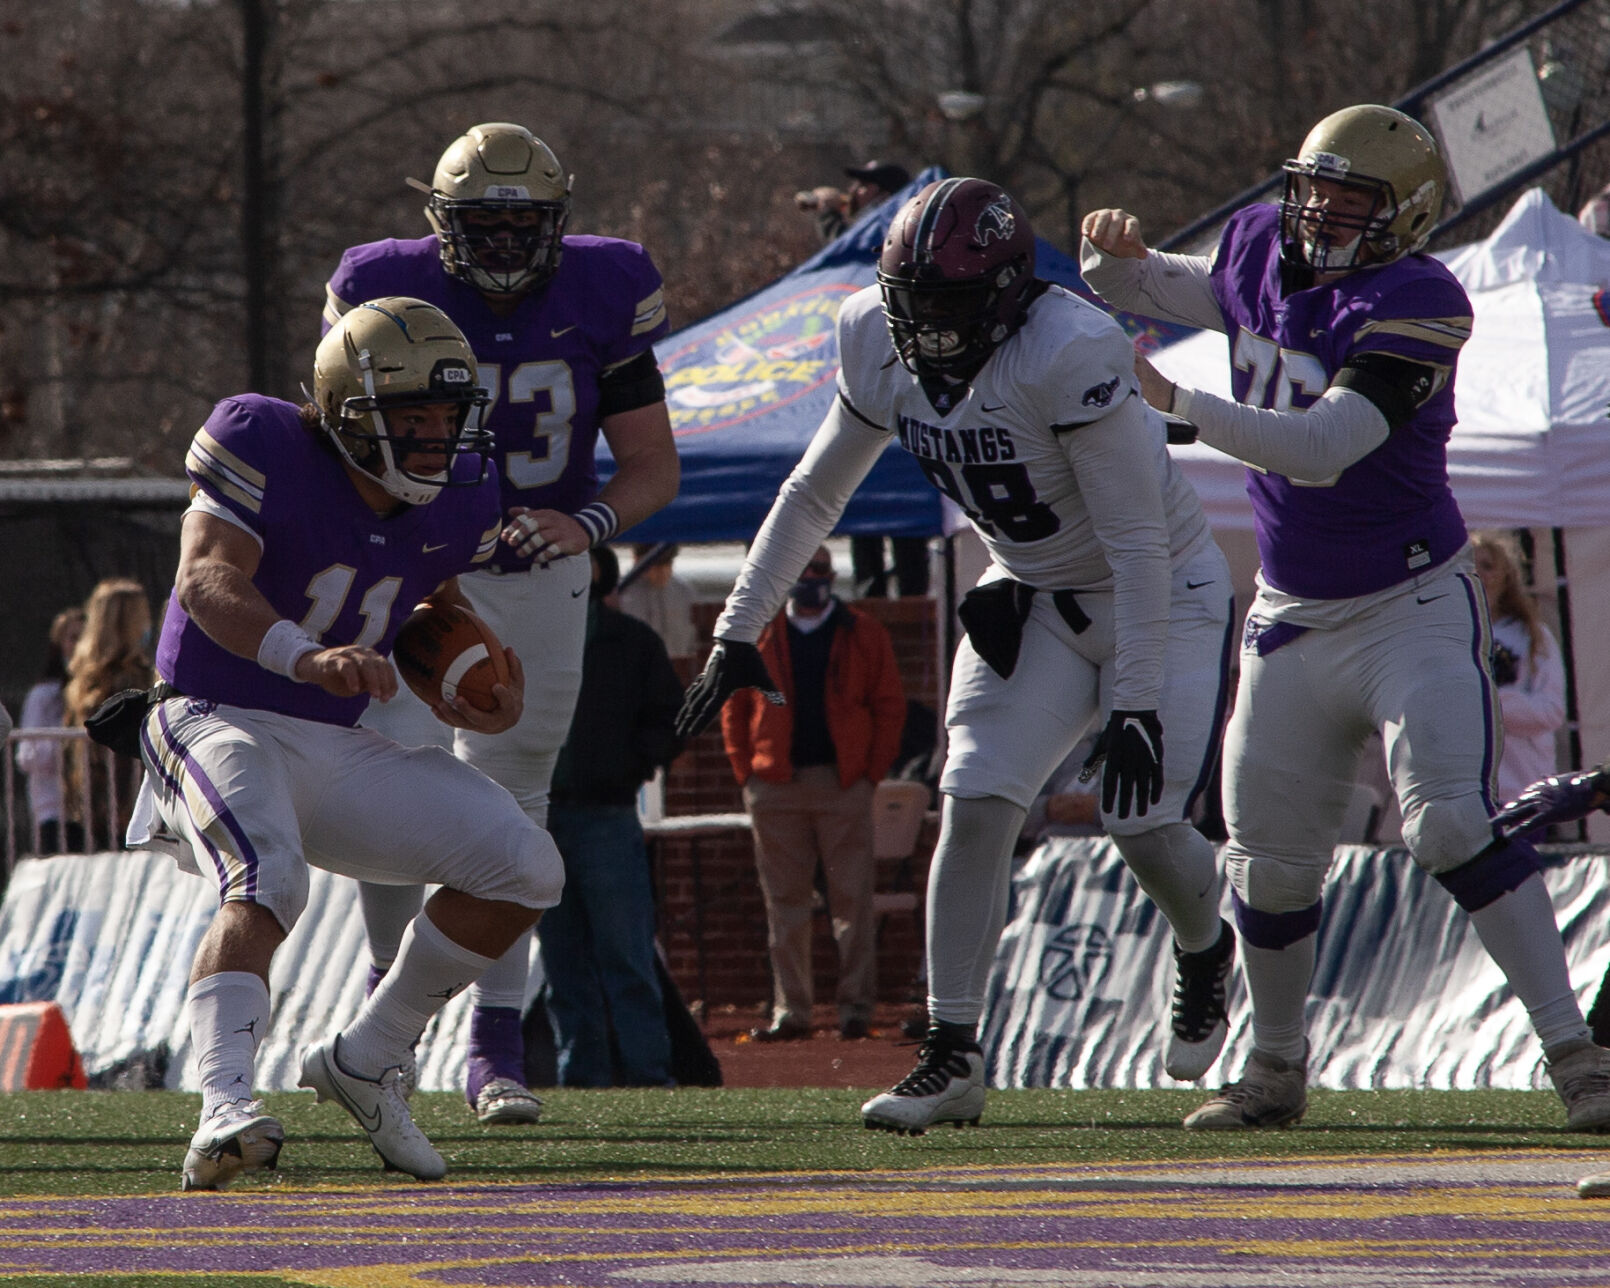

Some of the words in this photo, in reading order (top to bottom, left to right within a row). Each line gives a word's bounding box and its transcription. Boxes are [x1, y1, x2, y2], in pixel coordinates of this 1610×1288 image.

[497, 187, 519, 198] CPA
[447, 370, 466, 381] CPA
[897, 414, 1016, 464] MUSTANGS
[1409, 543, 1425, 555] XL
[299, 563, 404, 646] 11
